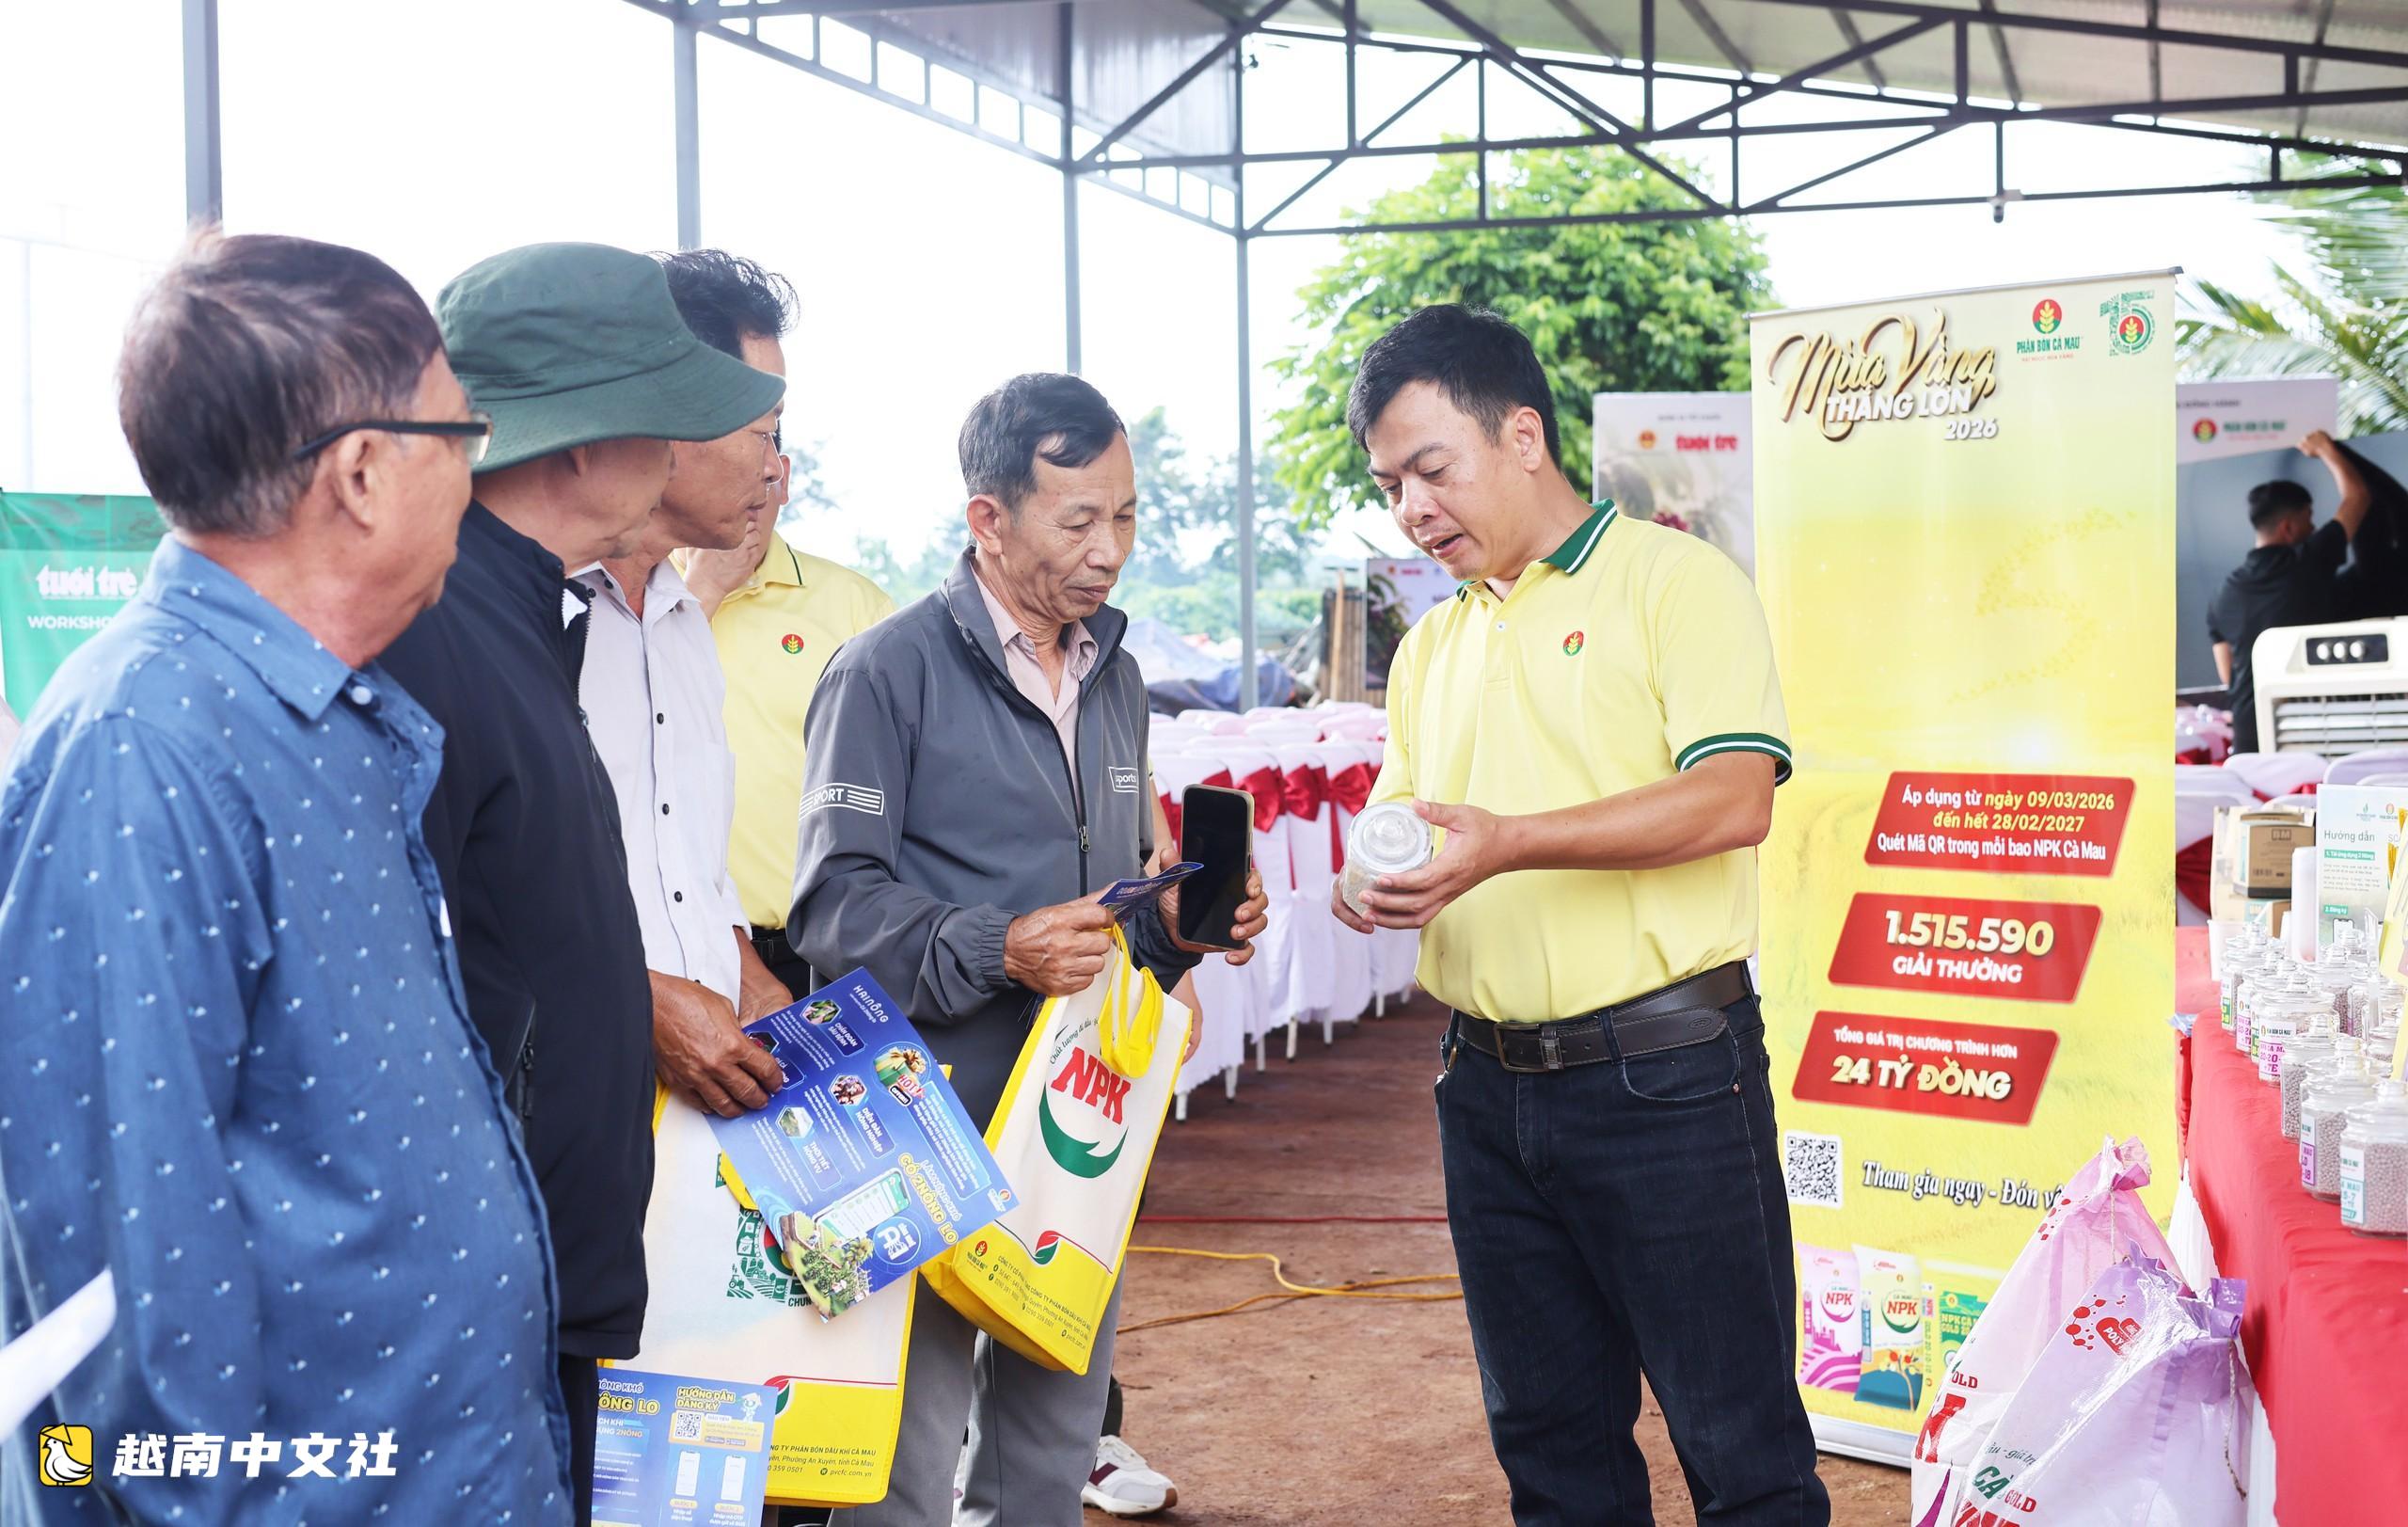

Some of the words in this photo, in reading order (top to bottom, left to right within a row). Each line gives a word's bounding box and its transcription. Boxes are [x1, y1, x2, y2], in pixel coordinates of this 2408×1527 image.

[2065, 336, 2080, 349] MAU
[1767, 331, 1886, 441] Mùa
[1861, 307, 1996, 412] Vàng
[1827, 384, 1913, 422] THẮNG
[1919, 382, 1972, 417] LỚN
[1944, 419, 1998, 440] 2026
[27, 615, 117, 630] WORKSHO
[814, 788, 844, 805] SPORT
[1902, 784, 1923, 807] Áp
[1925, 788, 1961, 809] dụng
[1965, 789, 1982, 805] từ
[1985, 790, 2022, 810] ngày
[2027, 791, 2115, 810] 09/03/2026
[1933, 810, 1960, 828] đến
[1964, 812, 1988, 829] hết
[1992, 814, 2084, 832] 28/02/2027
[1877, 833, 1905, 851] Quét
[1908, 834, 1925, 852] Mã
[1928, 835, 1945, 853] QR
[1947, 837, 1979, 859] trong
[1982, 835, 2005, 856] mỗi
[2008, 838, 2031, 857] bao
[2034, 839, 2062, 857] NPK
[2063, 839, 2079, 858] Cà
[2082, 841, 2106, 860] Mau
[2324, 830, 2355, 843] Hướng
[1885, 910, 2054, 956] 1.515.590
[1893, 951, 1932, 977] GIẢI
[1937, 957, 2022, 983] THƯỞNG
[1833, 1026, 1863, 1043] TỔNG
[1866, 1030, 1885, 1046] GIÁ
[1886, 1033, 1904, 1051] TRỊ
[1906, 1035, 1953, 1052] CHƯƠNG
[1955, 1039, 1988, 1057] TRÌNH
[1991, 1044, 2018, 1058] HƠN
[1051, 1046, 1132, 1125] NPK
[1830, 1055, 1871, 1085] 24
[1877, 1054, 1914, 1089] TỶ
[1917, 1056, 2012, 1100] ĐỒNG
[1862, 1160, 1909, 1190] Tham
[1912, 1169, 1940, 1200] gia
[1943, 1178, 1986, 1207] ngay
[2001, 1178, 2038, 1208] Đón
[898, 1153, 922, 1176] CÓ
[910, 1174, 946, 1224] 2NÔNG
[938, 1221, 958, 1245] LO
[788, 1297, 812, 1307] CHUN
[1825, 1293, 1853, 1305] NPK
[1887, 1301, 1918, 1315] NPK
[598, 1379, 622, 1392] ÔNG
[622, 1381, 643, 1393] KHÓ
[1952, 1371, 1978, 1389] OLD
[598, 1391, 634, 1411] ÔNG
[637, 1399, 659, 1415] LO
[677, 1386, 714, 1399] HƯỚNG
[705, 1400, 721, 1411] KÝ
[2004, 1489, 2036, 1512] GOLD
